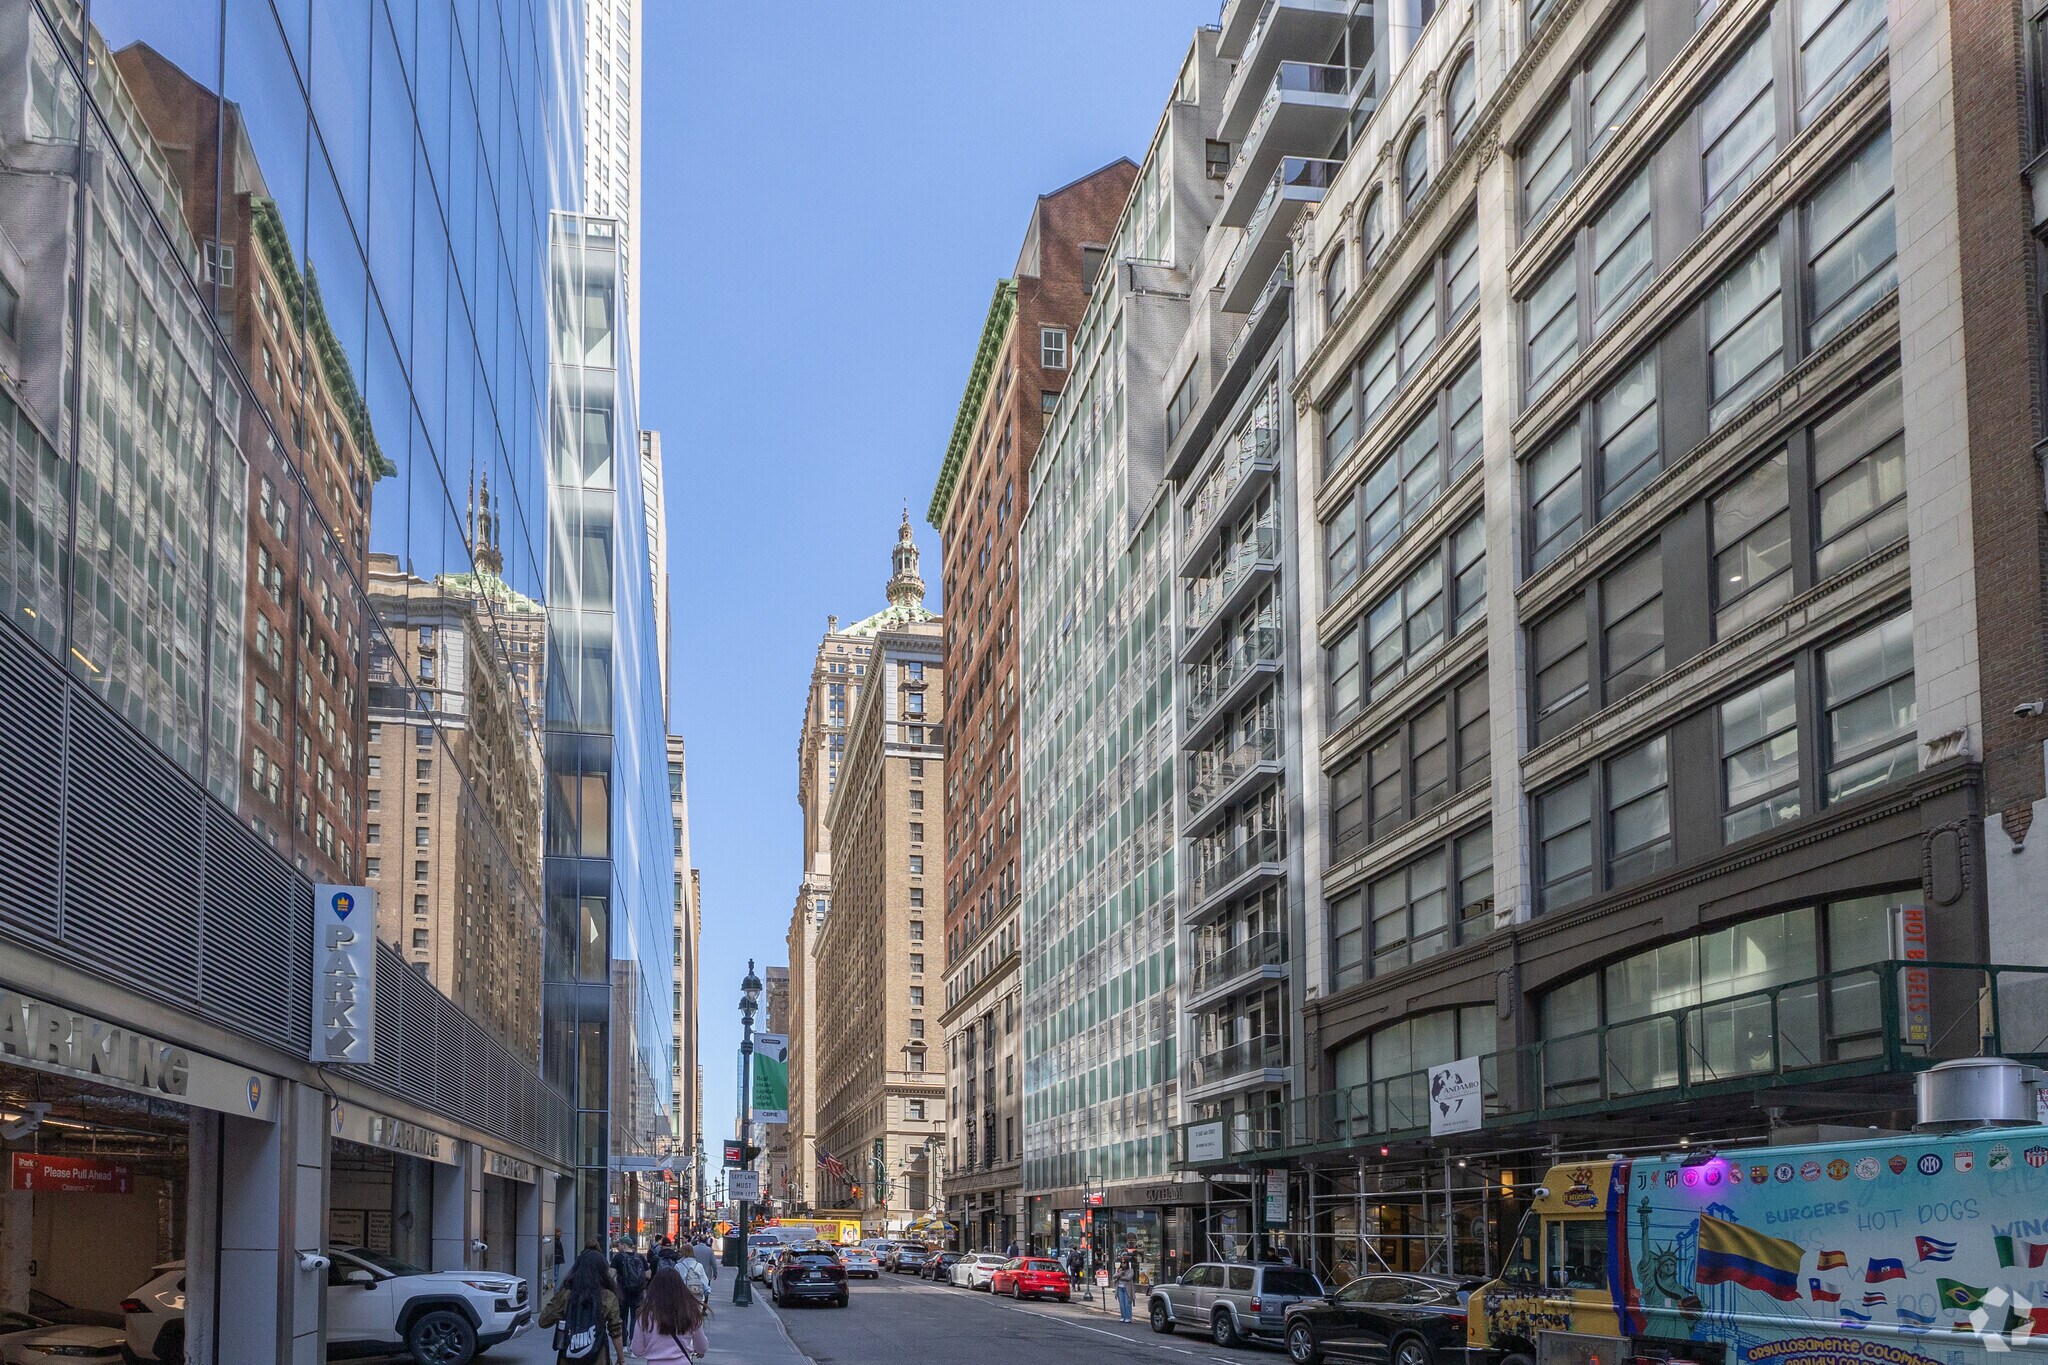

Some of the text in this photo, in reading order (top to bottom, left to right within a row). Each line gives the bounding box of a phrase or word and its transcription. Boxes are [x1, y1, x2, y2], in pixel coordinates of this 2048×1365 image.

[1905, 909, 1929, 1012] HOT BGELS
[323, 924, 357, 1028] PARK
[1444, 1081, 1479, 1094] ANDAMIO
[1454, 1099, 1463, 1113] 7
[382, 1117, 439, 1157] PARKING
[19, 1158, 34, 1167] iPark
[44, 1166, 112, 1181] Please Pull Ahead
[1146, 1187, 1183, 1201] GOTHAM
[1765, 1198, 1981, 1232] BURGERS HOT DOGS
[570, 1325, 596, 1350] NIKE
